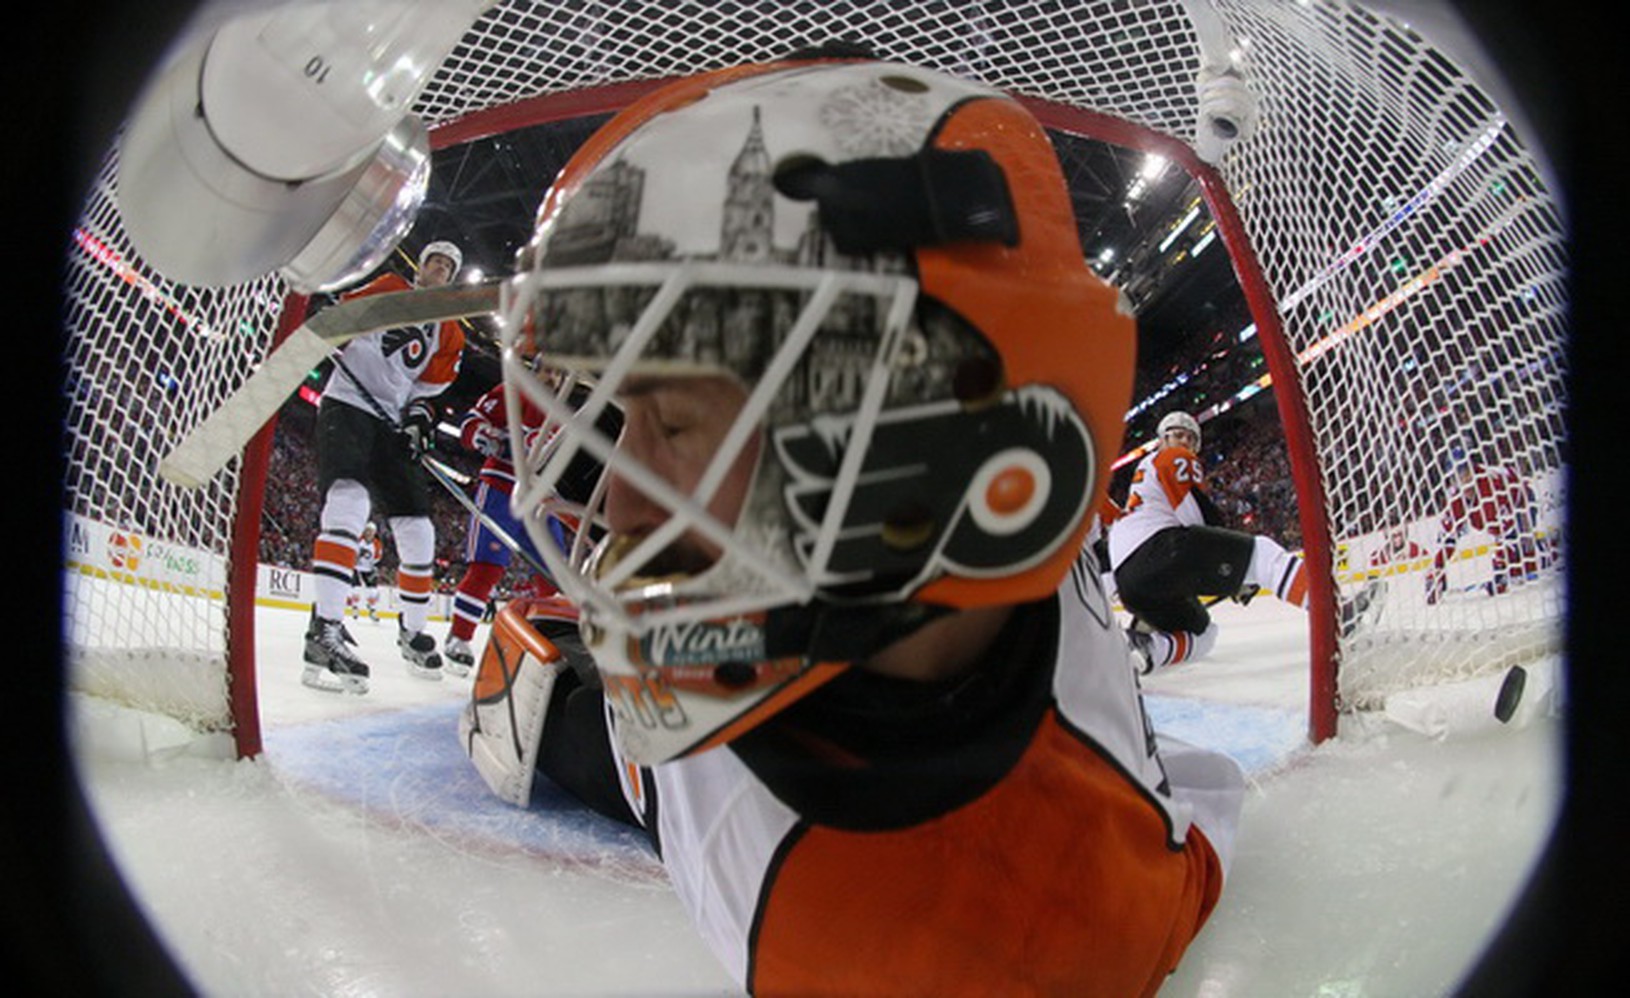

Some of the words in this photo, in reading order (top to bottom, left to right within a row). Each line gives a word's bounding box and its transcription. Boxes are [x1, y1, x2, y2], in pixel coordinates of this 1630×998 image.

[304, 55, 332, 84] 10
[1173, 457, 1204, 482] 25
[270, 569, 301, 592] RCI
